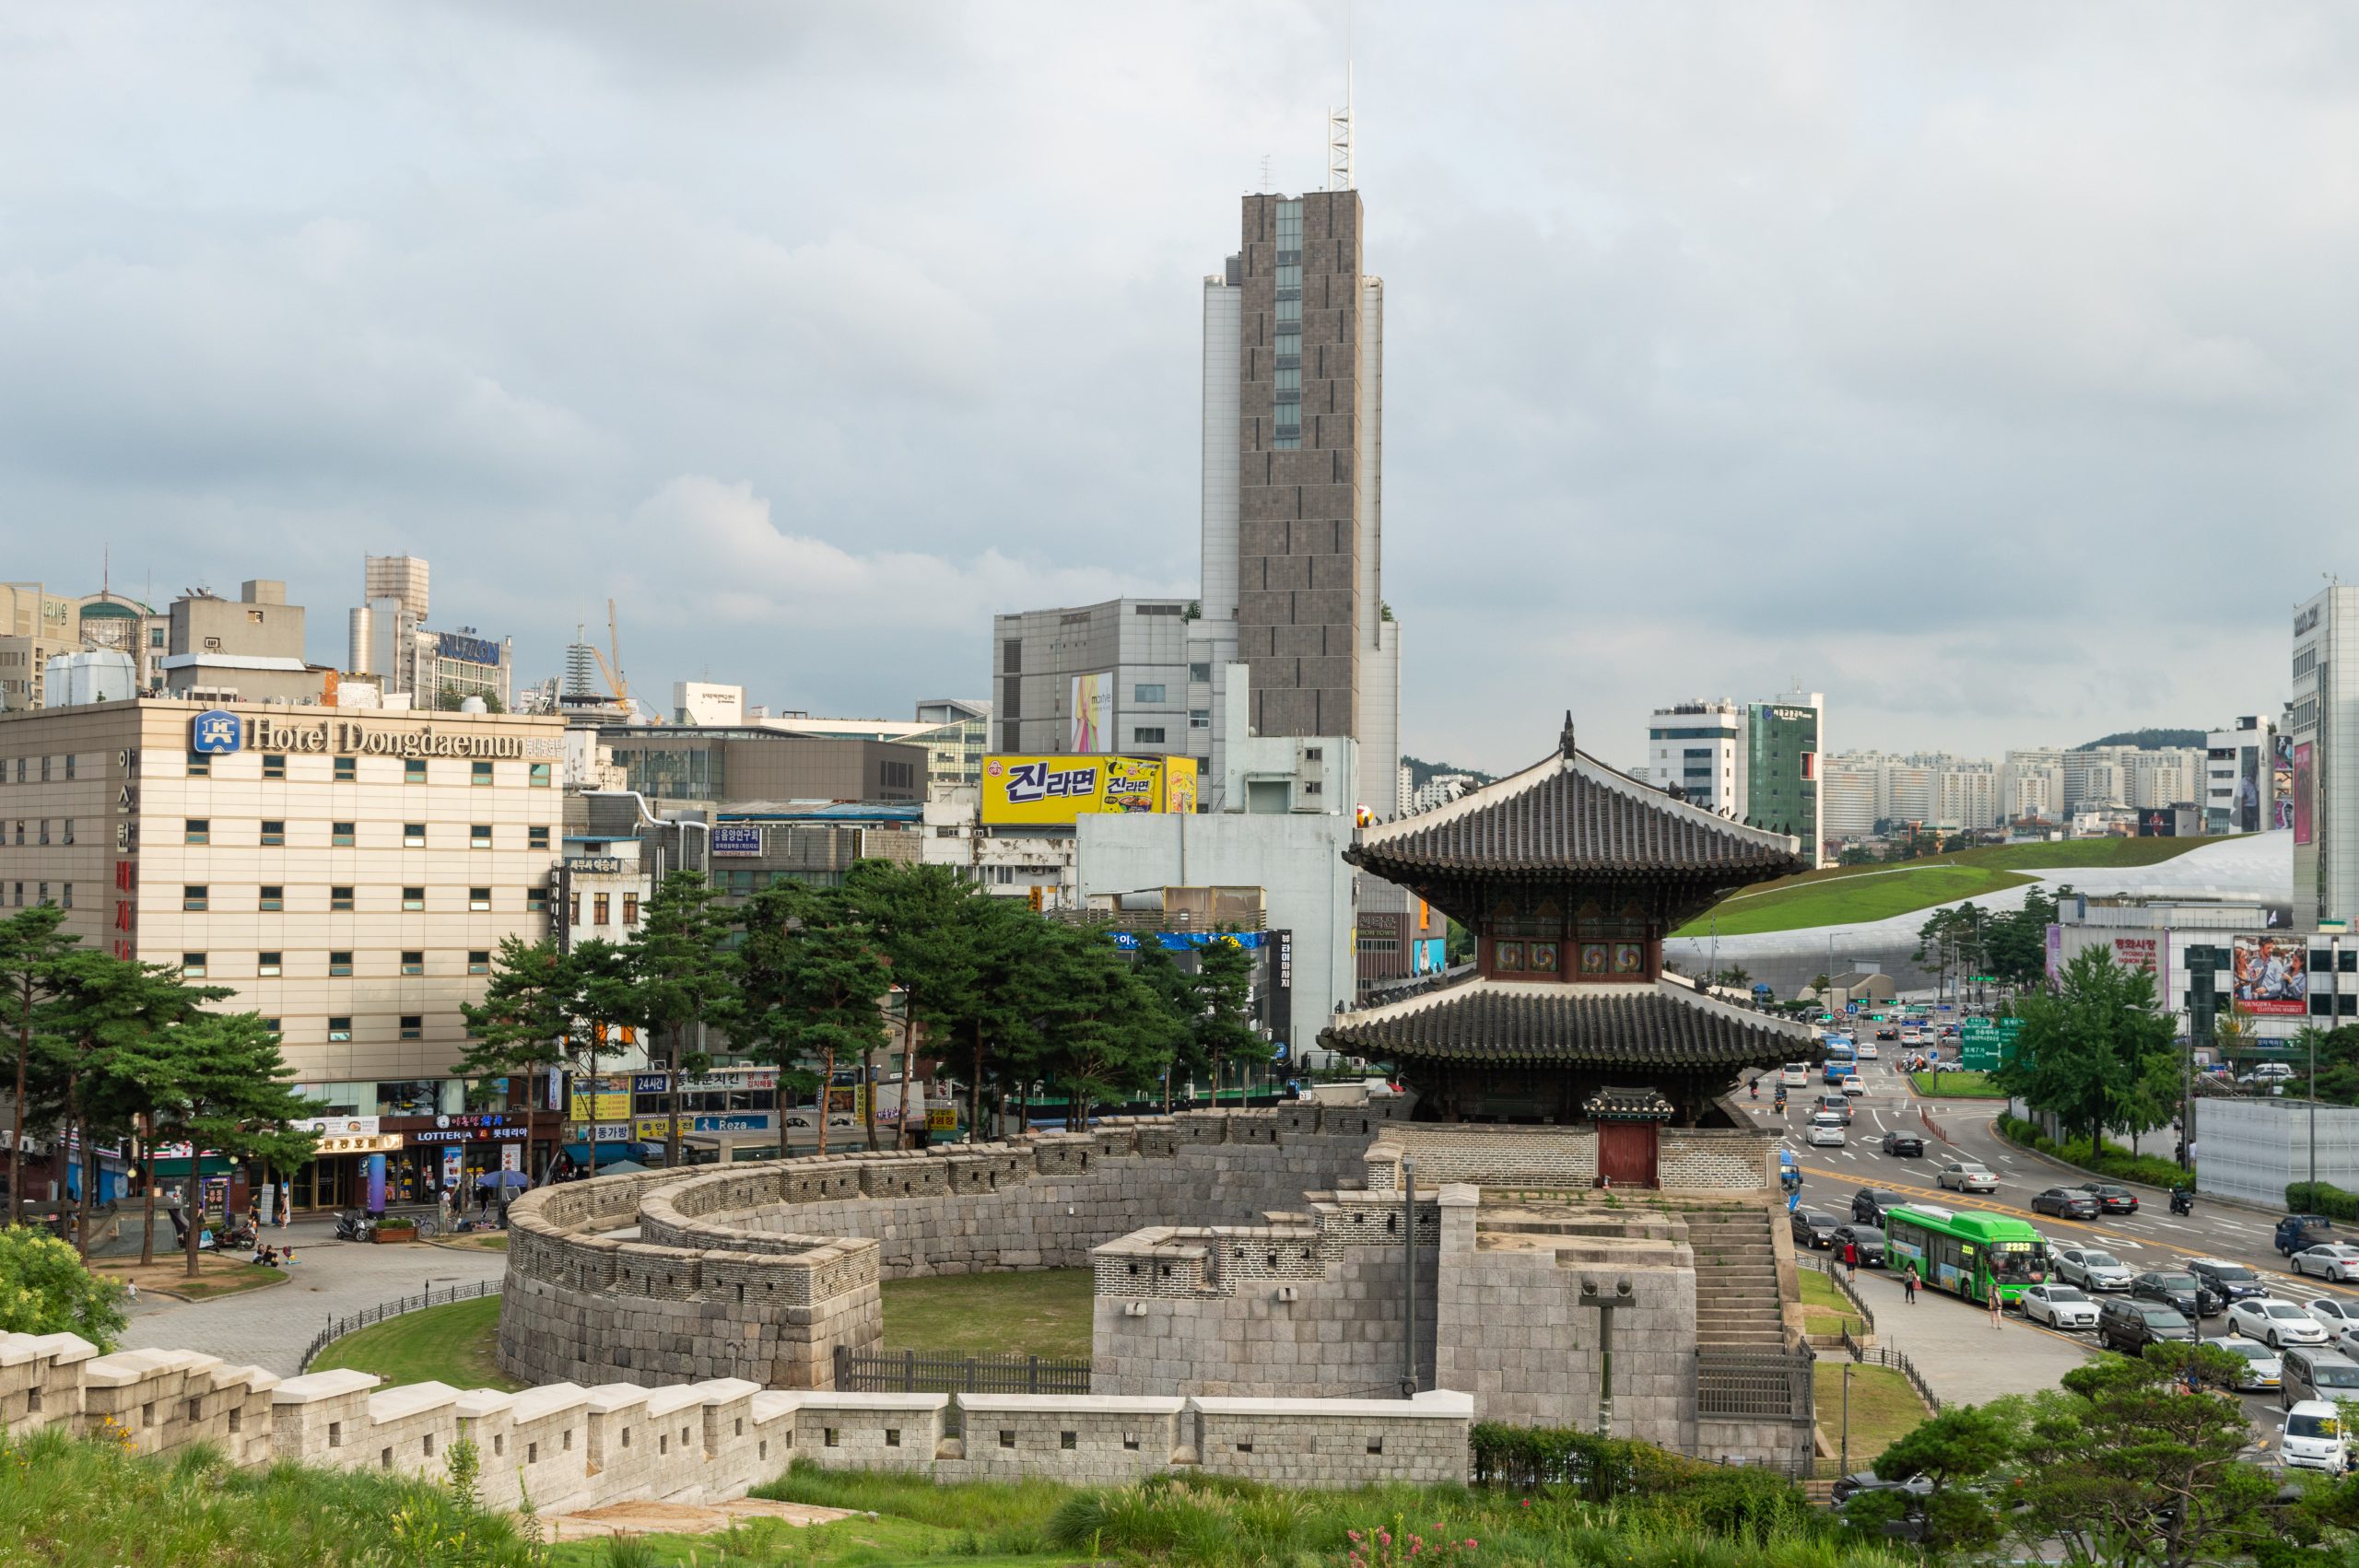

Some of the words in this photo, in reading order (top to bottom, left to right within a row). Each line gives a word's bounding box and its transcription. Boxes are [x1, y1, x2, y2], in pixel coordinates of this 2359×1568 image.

[440, 632, 500, 665] NUZZON
[251, 717, 333, 751] Hotel
[344, 719, 526, 757] Dongdaemun
[1004, 761, 1096, 803] 진라면
[1107, 776, 1149, 794] 진라면
[722, 829, 759, 842] 음양연구회
[2115, 938, 2157, 951] 평화시장
[638, 1076, 664, 1091] 24시간
[856, 1085, 865, 1115] 양념치킨
[720, 1119, 747, 1130] Reza
[417, 1130, 473, 1141] LOTTERA
[493, 1128, 528, 1139] 롯데리아
[1962, 1244, 1974, 1256] 2233
[2005, 1242, 2031, 1252] 2233
